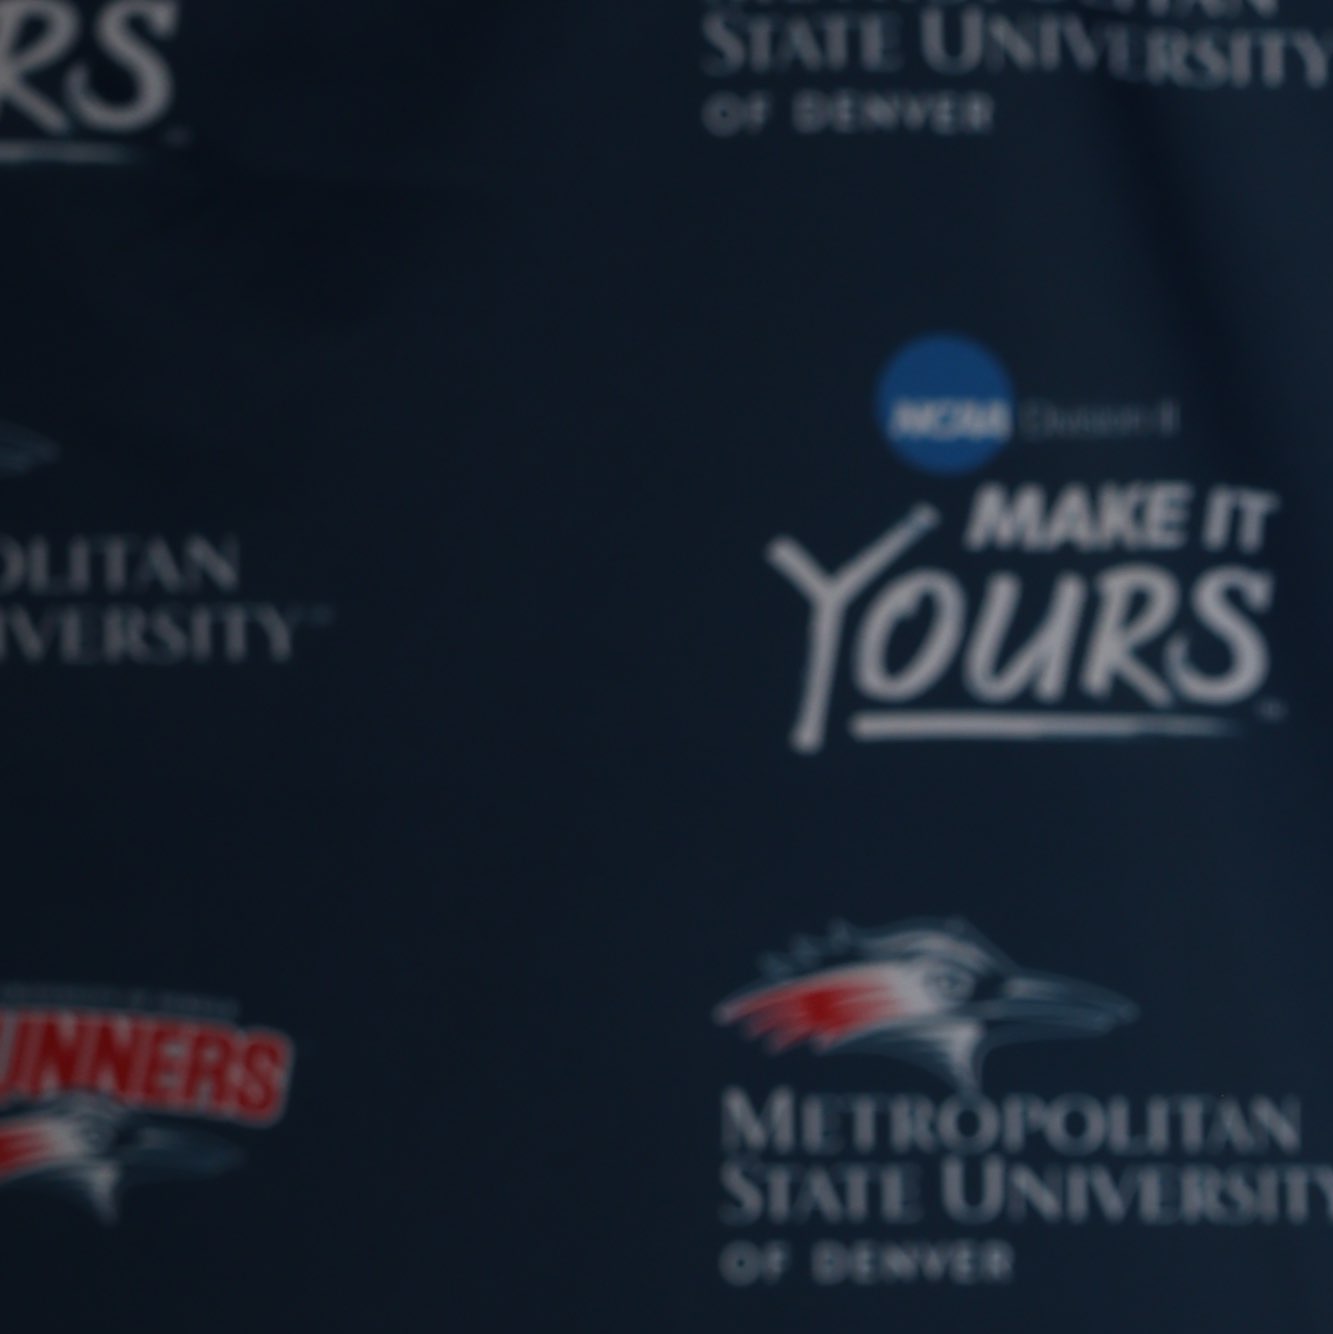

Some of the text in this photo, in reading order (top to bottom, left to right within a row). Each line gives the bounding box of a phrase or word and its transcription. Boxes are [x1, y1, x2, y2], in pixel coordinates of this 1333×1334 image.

[702, 1, 1332, 90] STATE UNIVERSITY
[702, 90, 994, 137] OF DENVER
[962, 479, 1282, 555] MAKE IT
[764, 500, 1278, 756] YOURS
[720, 1084, 1300, 1156] METROPOLITAN
[719, 1161, 922, 1225] STATE
[718, 1238, 1015, 1288] OF DENVER
